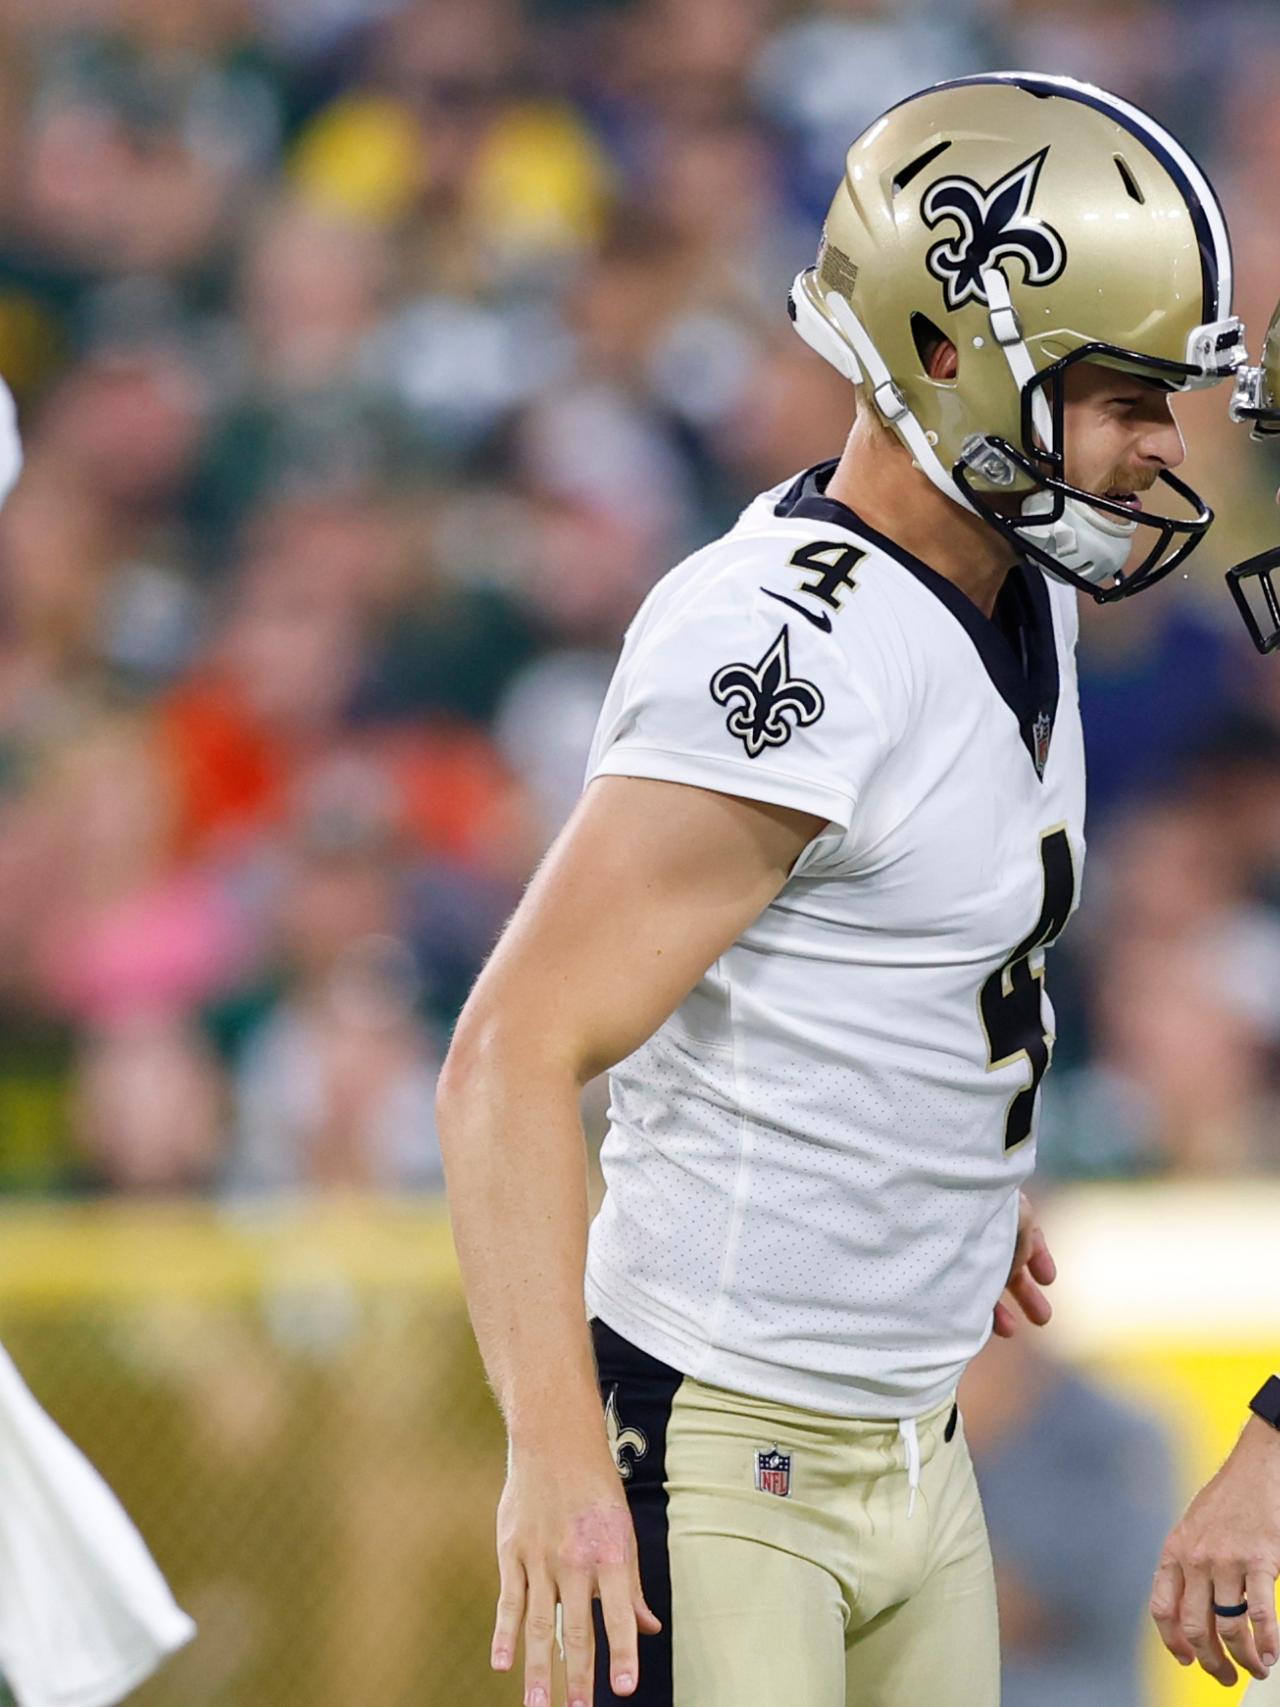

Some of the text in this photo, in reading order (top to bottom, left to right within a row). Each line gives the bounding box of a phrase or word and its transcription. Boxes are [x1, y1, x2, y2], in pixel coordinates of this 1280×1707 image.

[786, 540, 870, 613] 4
[978, 822, 1075, 1154] 4
[762, 1471, 787, 1493] NFL
